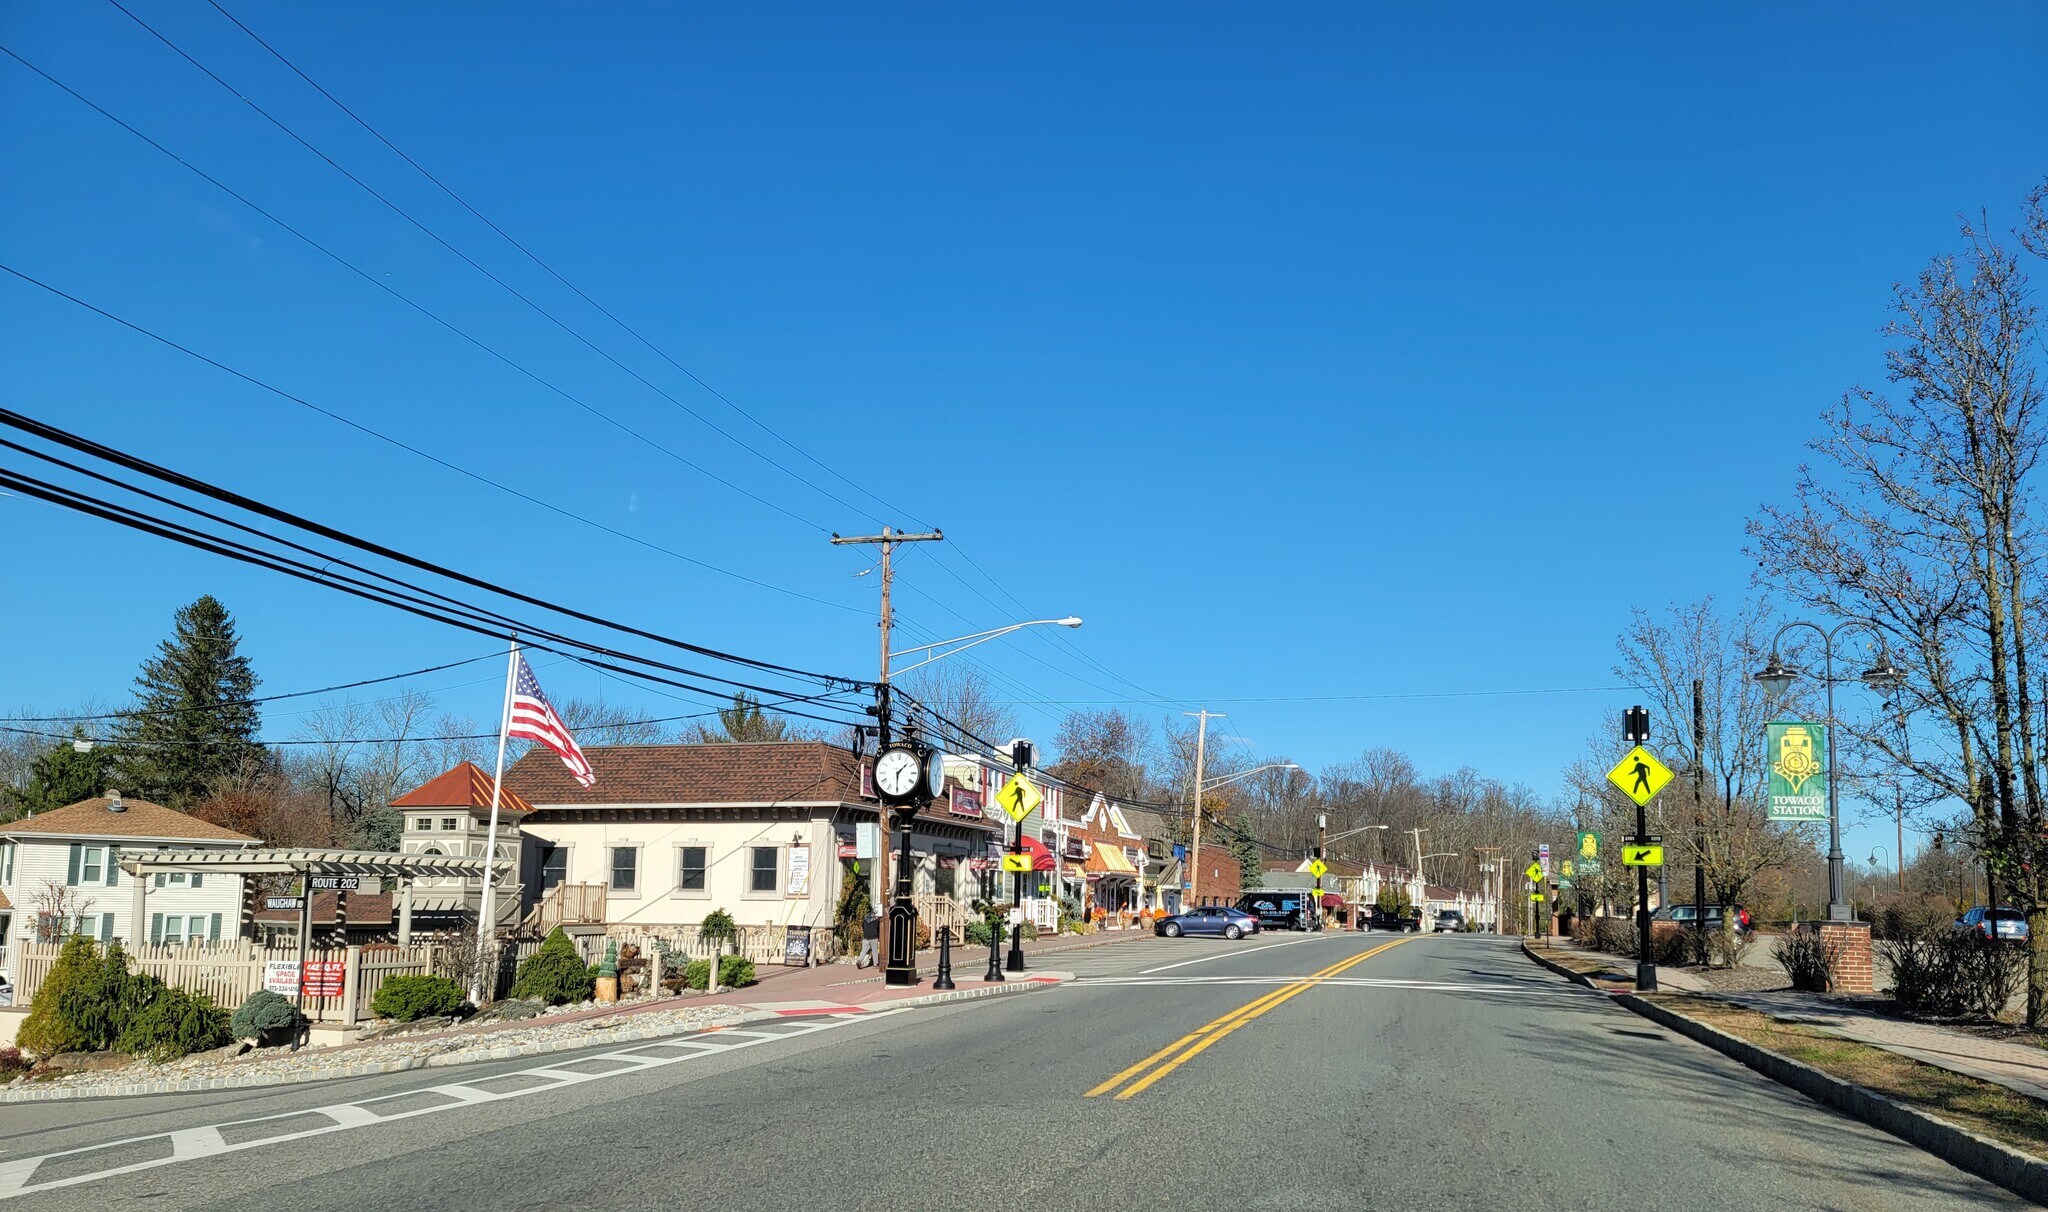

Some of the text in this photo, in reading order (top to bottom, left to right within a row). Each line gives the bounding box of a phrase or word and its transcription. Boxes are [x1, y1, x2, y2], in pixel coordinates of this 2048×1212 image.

[1772, 796, 1821, 805] TOWACO
[1772, 805, 1821, 815] STATION
[312, 877, 358, 889] ROUTE 202
[267, 898, 303, 908] WAUGHAW RD
[275, 970, 296, 978] SPACE
[269, 977, 300, 985] AVAILABLE
